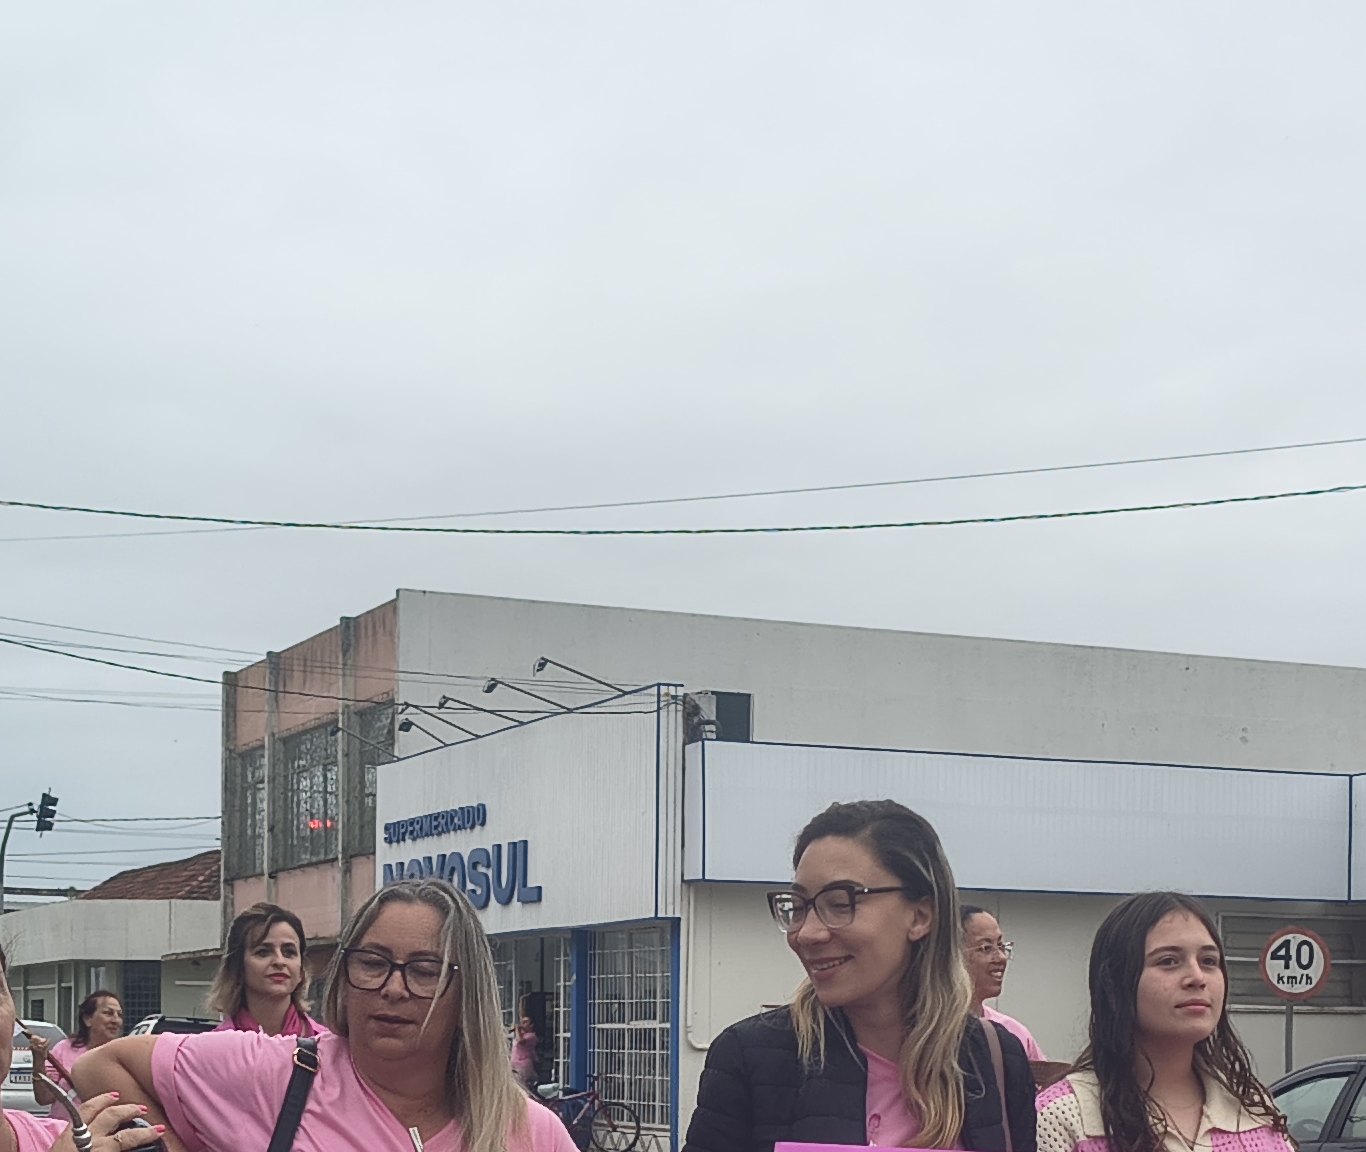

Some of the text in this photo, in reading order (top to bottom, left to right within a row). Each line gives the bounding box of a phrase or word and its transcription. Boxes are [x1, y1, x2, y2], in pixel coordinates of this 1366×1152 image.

[384, 803, 487, 844] SUPERMERCADO
[1270, 939, 1314, 970] 40
[1276, 973, 1313, 987] km/h
